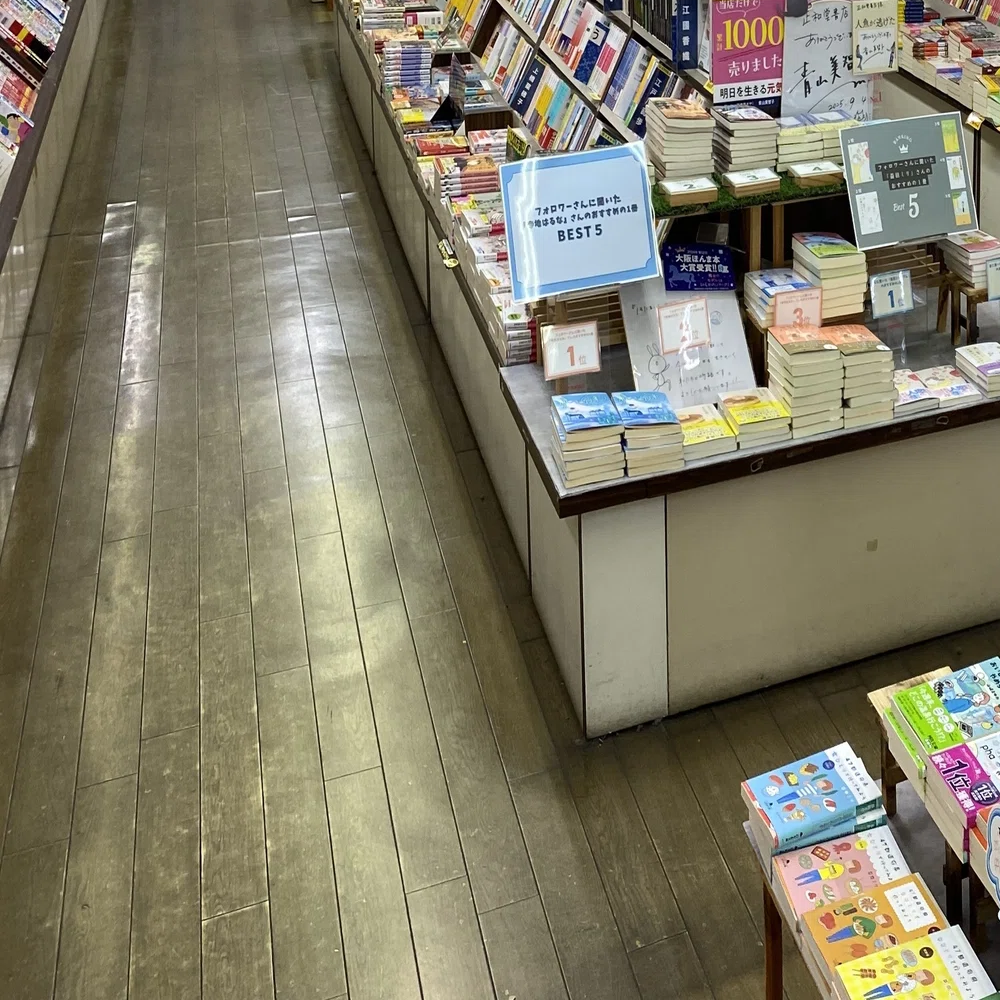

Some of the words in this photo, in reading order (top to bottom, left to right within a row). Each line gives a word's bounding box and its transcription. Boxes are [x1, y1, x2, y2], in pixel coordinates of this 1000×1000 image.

[723, 16, 784, 51] 1000
[728, 54, 783, 77] 売りました
[535, 194, 622, 216] フォロワーさんに聞いた
[909, 193, 920, 218] 5
[558, 225, 591, 242] BEST
[594, 224, 603, 236] 5
[675, 254, 721, 264] 大阪ほんま本
[980, 744, 996, 761] pha
